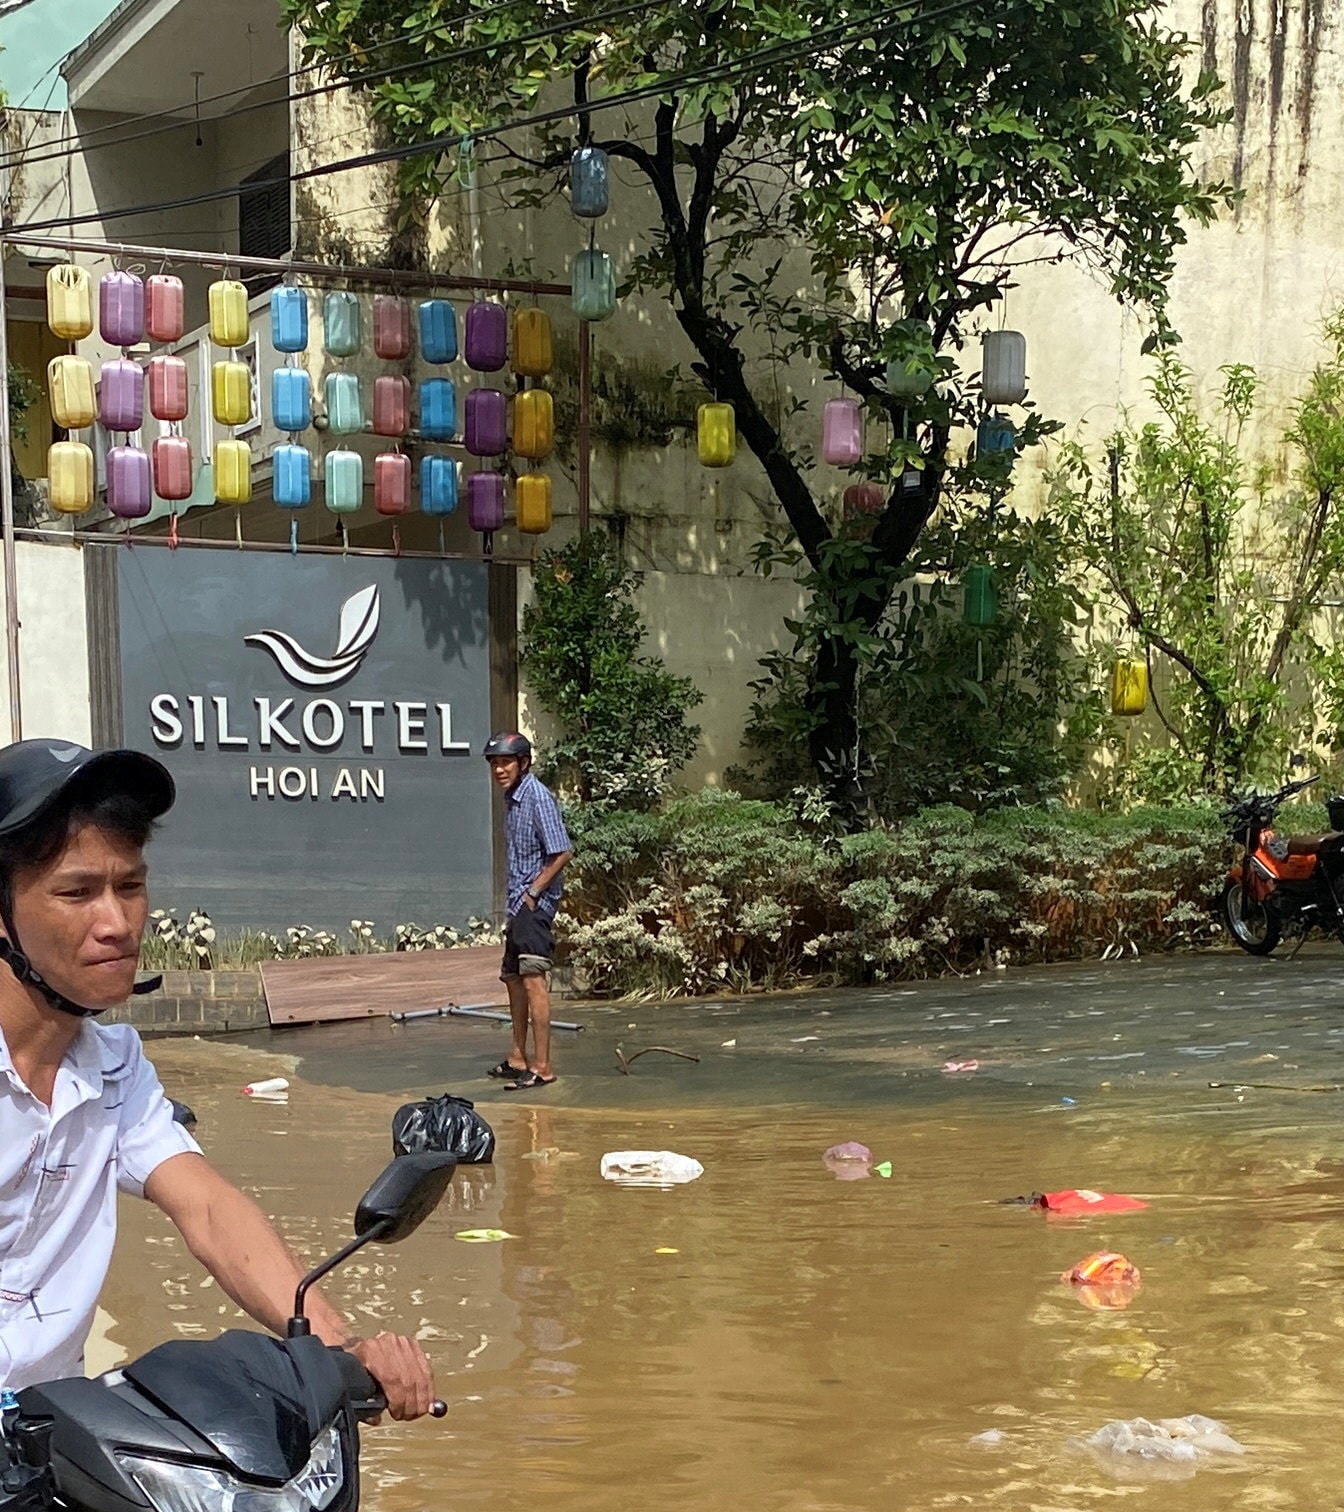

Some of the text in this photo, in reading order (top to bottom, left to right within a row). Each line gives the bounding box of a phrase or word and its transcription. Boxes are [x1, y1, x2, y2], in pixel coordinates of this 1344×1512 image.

[150, 694, 470, 749] SILKOTEL
[249, 766, 385, 799] HOI AN
